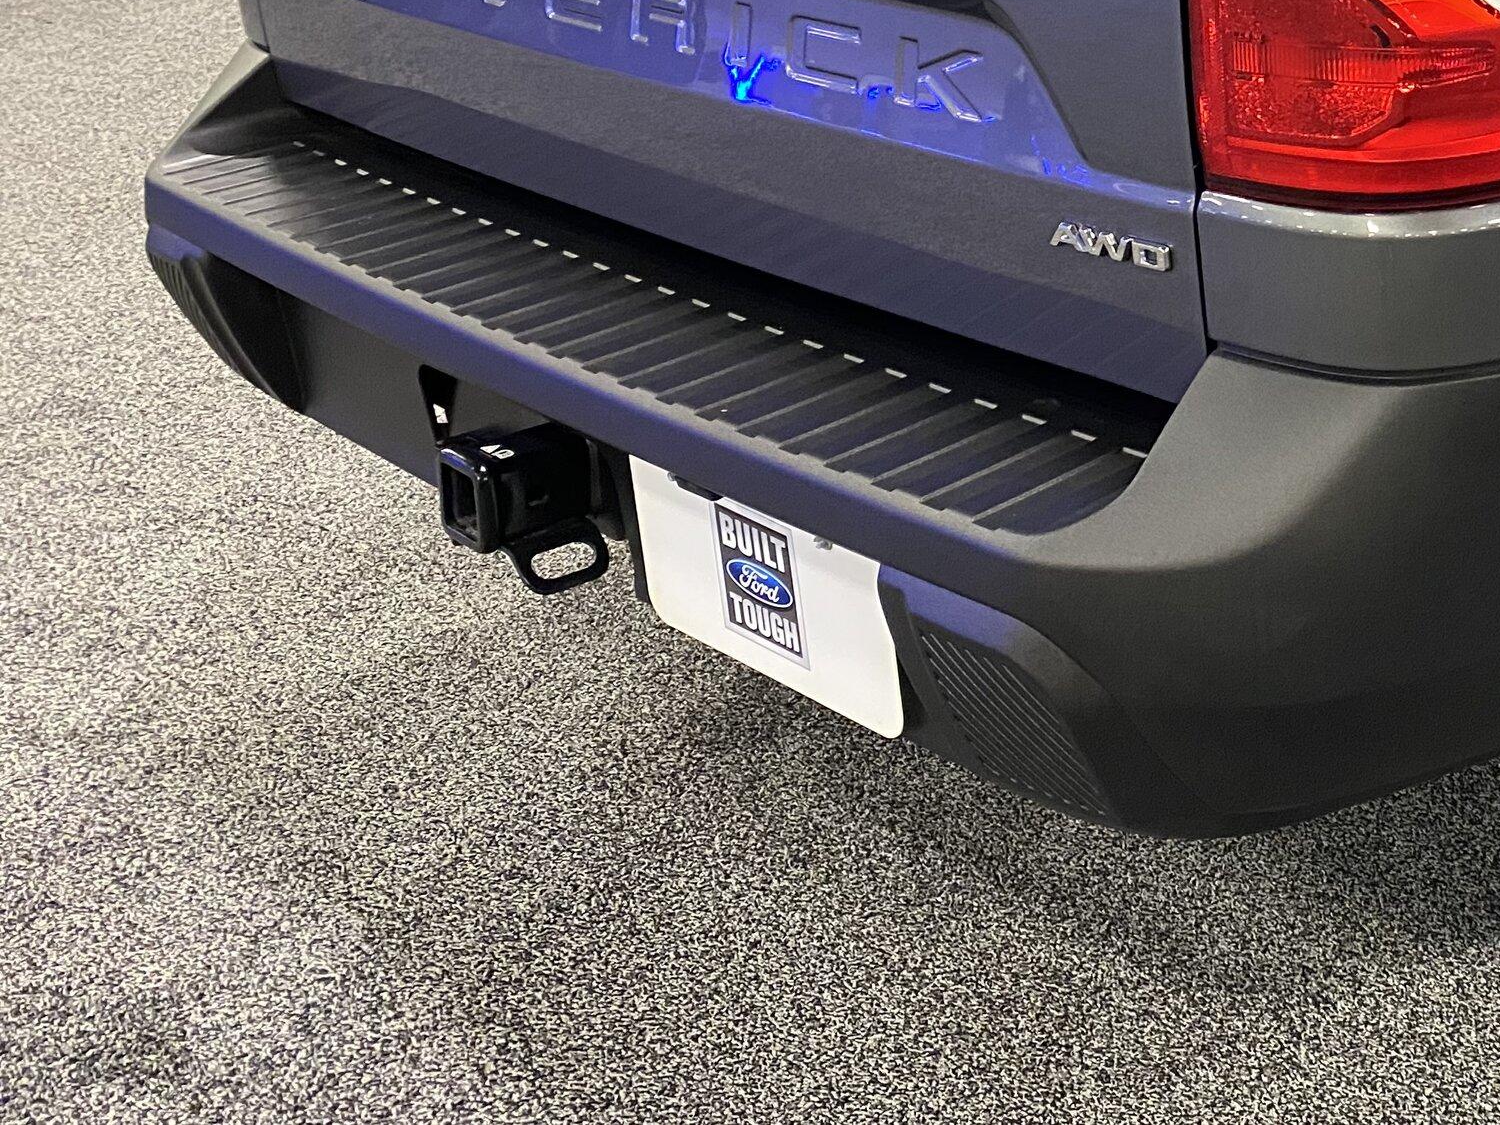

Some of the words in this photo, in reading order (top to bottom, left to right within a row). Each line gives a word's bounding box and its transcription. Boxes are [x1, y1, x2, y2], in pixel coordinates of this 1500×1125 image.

[1050, 221, 1174, 272] AWD
[718, 511, 786, 573] BUILT
[739, 564, 780, 603] Ford
[729, 591, 800, 653] TOUGH
